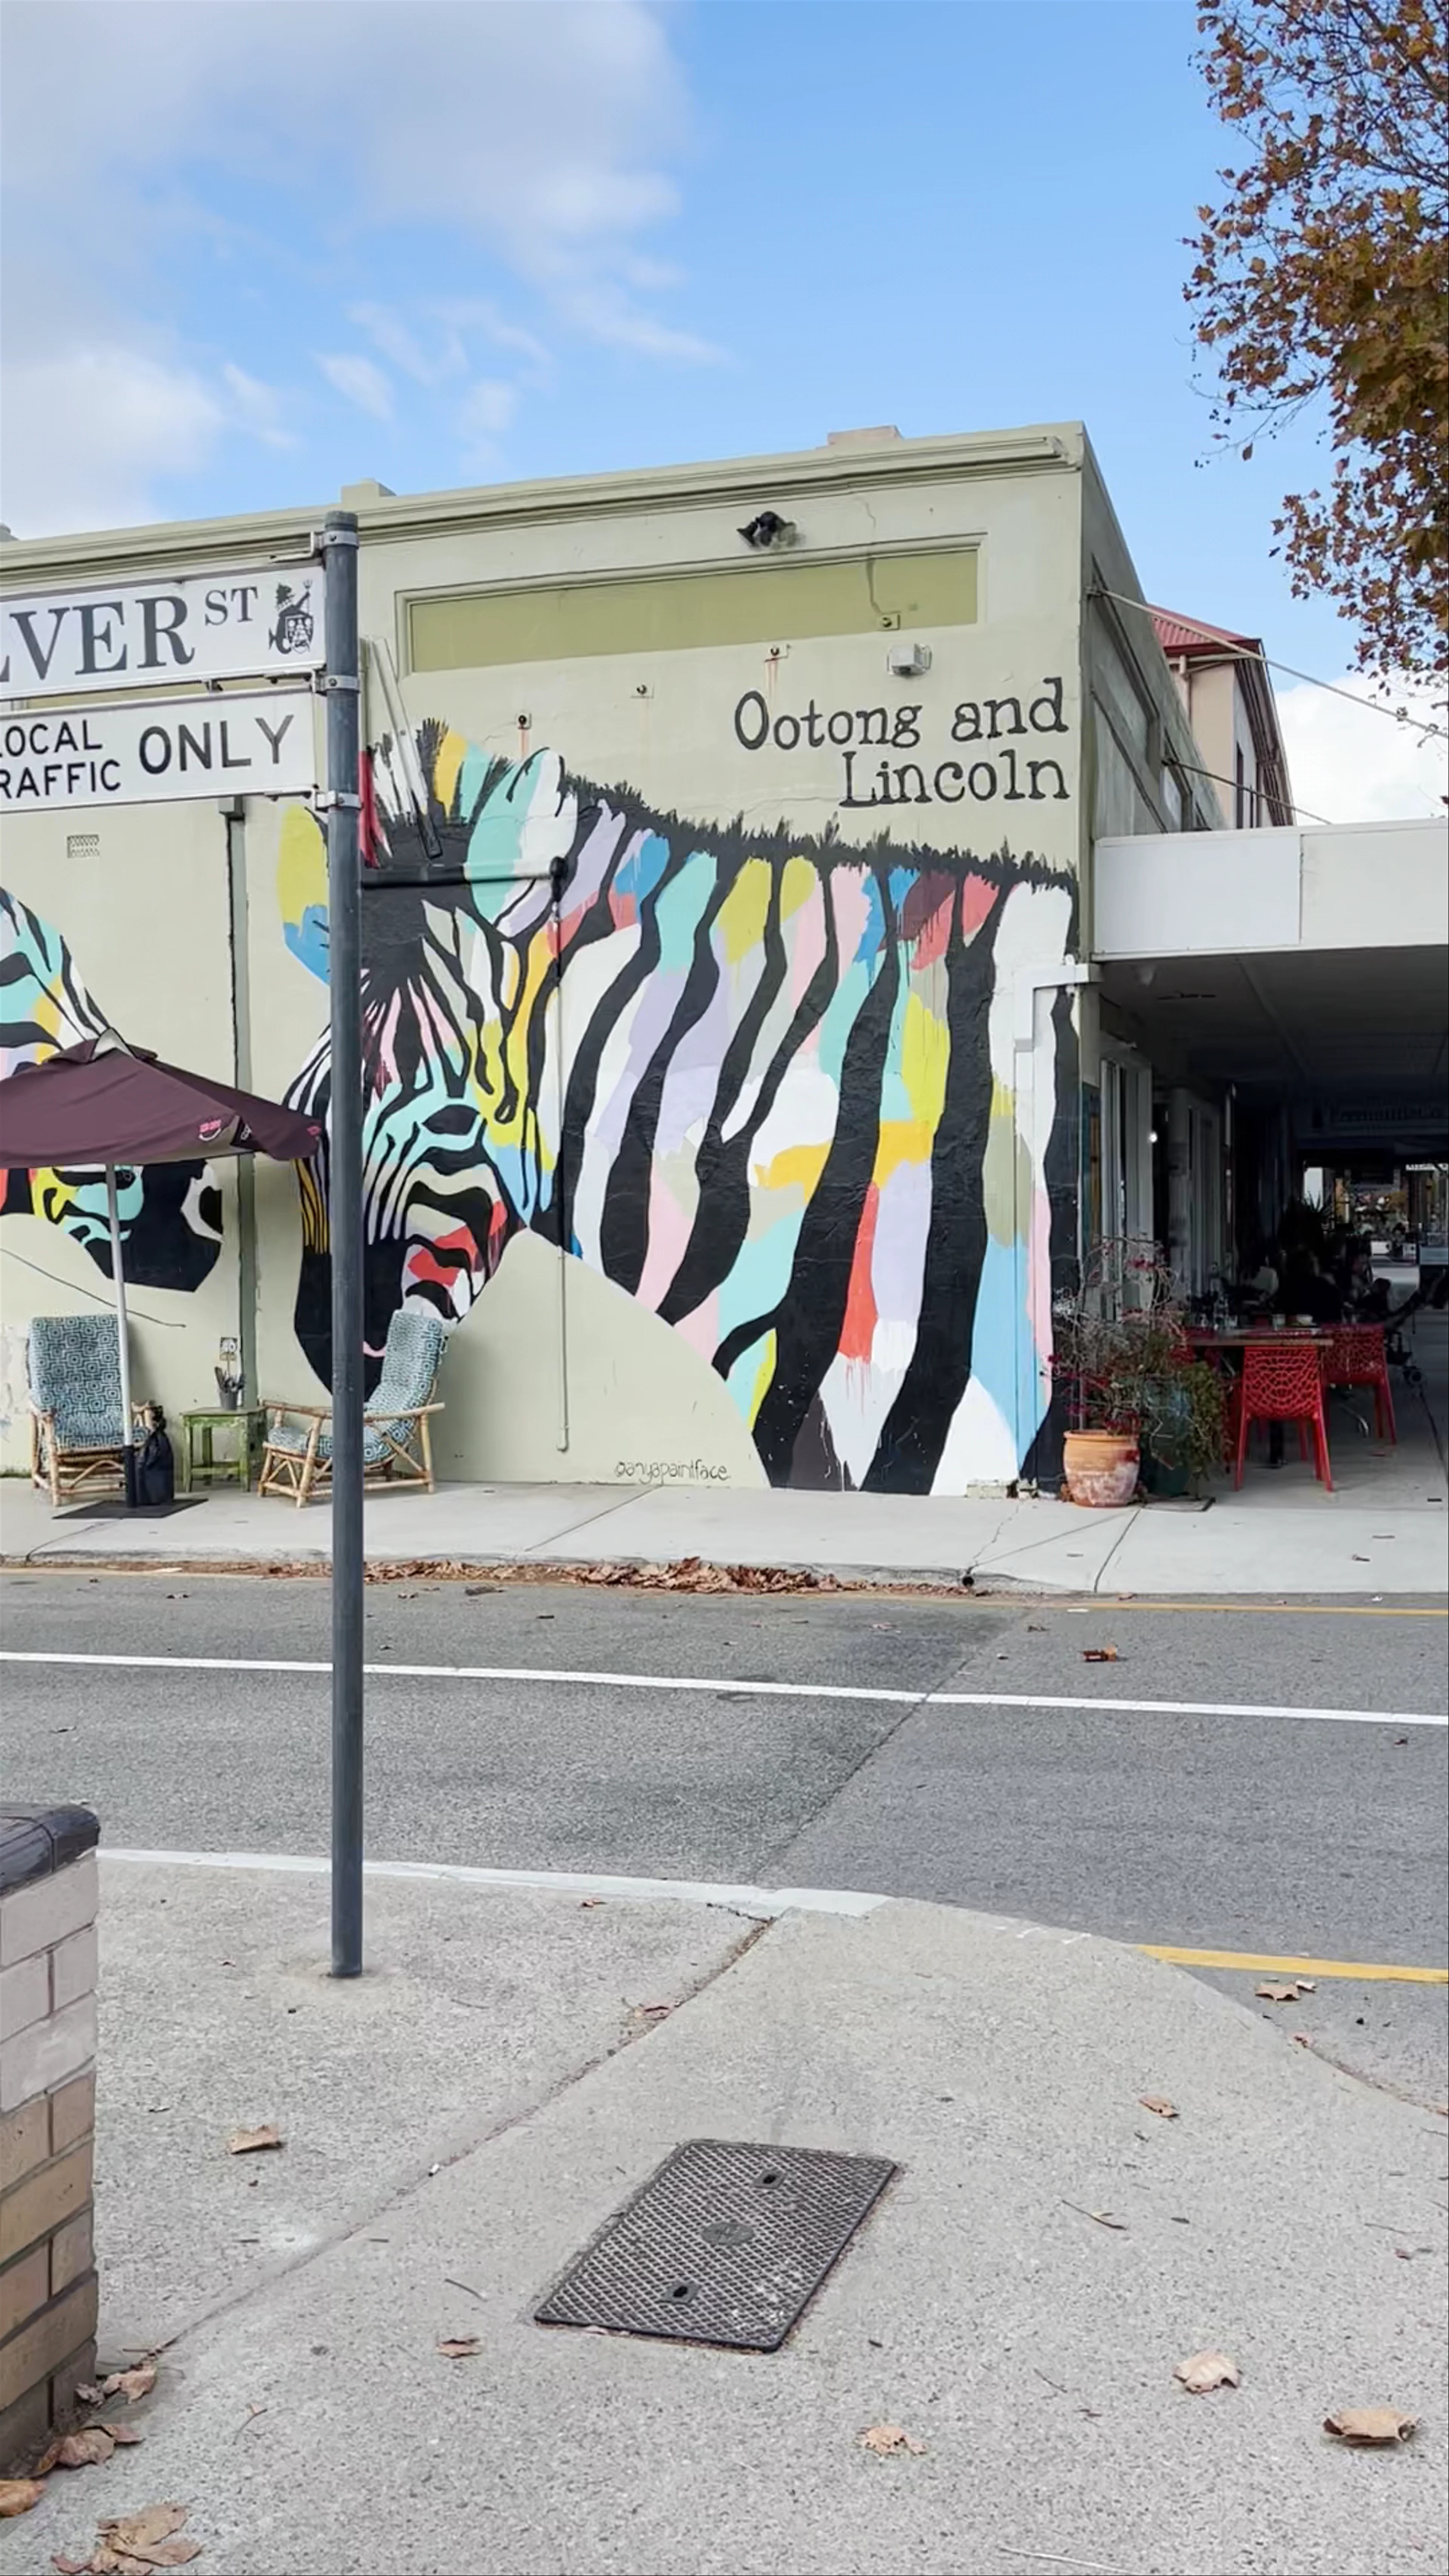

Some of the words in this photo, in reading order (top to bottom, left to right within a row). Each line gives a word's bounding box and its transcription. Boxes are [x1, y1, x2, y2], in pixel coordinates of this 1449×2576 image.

[205, 586, 258, 626] ST
[0, 719, 103, 757] OCAL
[734, 690, 923, 750] Ootong
[951, 677, 1069, 742] and
[138, 714, 294, 775] ONLY
[839, 749, 1070, 807] Lincoln
